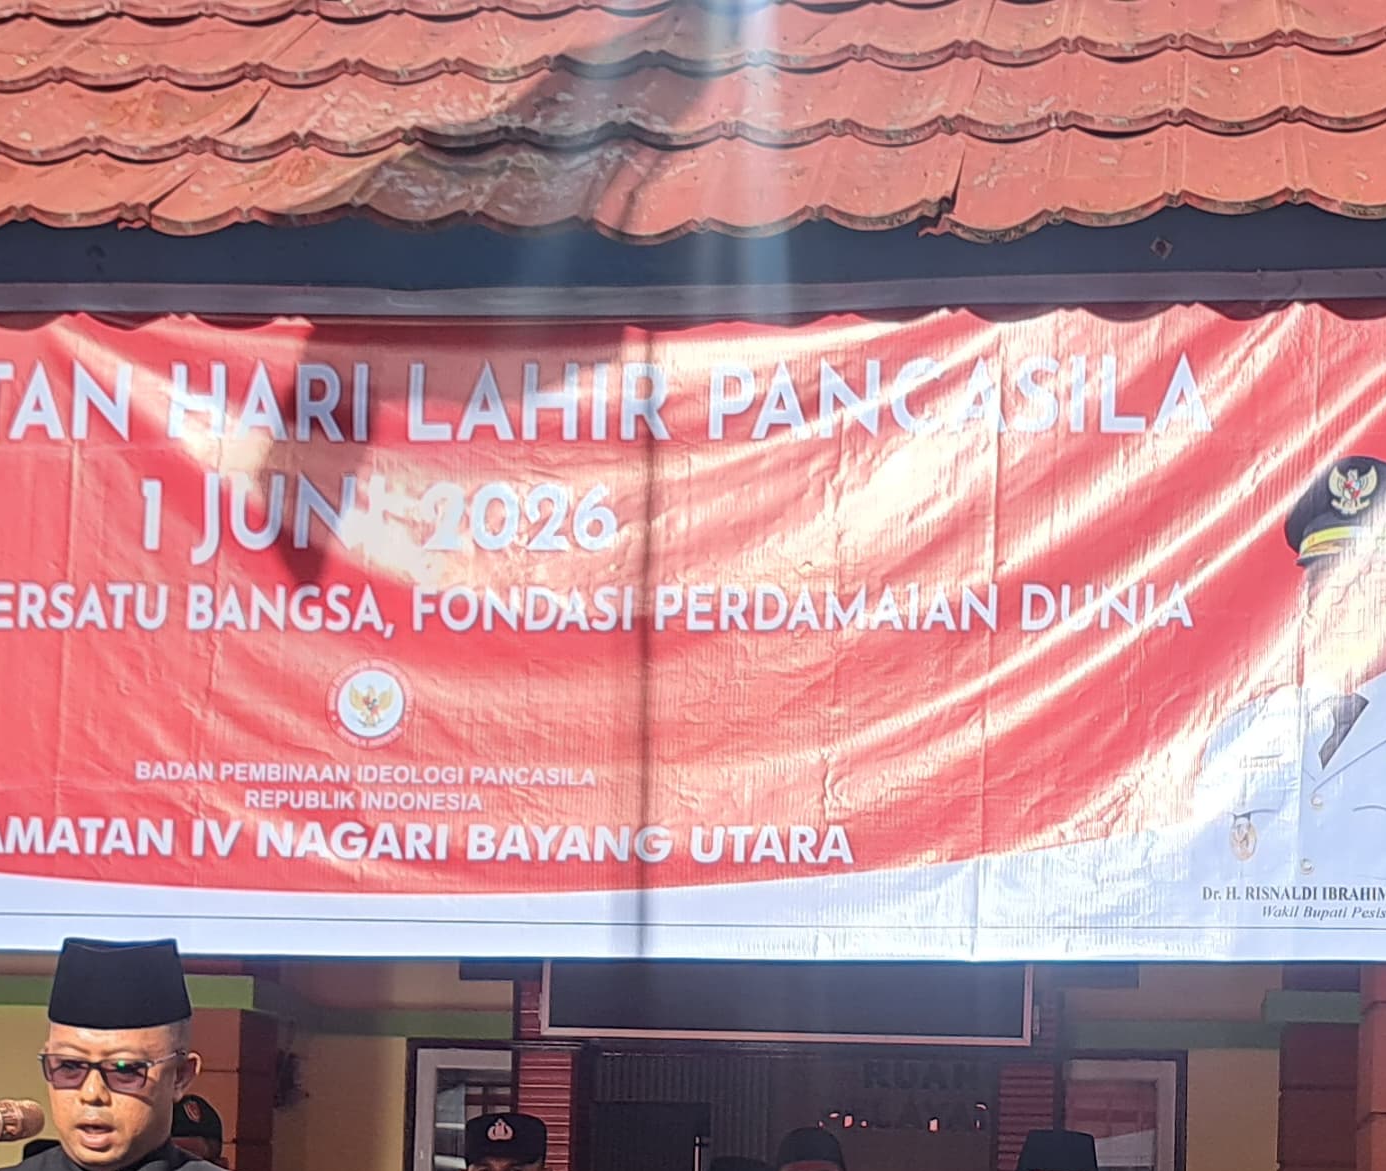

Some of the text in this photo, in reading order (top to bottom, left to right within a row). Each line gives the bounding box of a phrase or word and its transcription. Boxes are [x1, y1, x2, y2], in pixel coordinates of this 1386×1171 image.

[166, 360, 369, 443] HARI
[407, 359, 670, 443] LAHIR
[708, 352, 1212, 440] PANCASILA
[141, 478, 162, 551] 1
[419, 480, 617, 552] 2026
[186, 583, 394, 639] BANGSA,
[413, 583, 632, 632] FONDASI
[654, 582, 998, 632] PERDAMAIAN
[1020, 581, 1195, 631] DUNIA
[134, 760, 595, 787] BADAN PEMBINAAN IDEOLOGI PANCASILA
[245, 791, 482, 811] REPUBLIK INDONESIA
[192, 818, 243, 856] IV
[256, 820, 448, 861] NAGARI
[466, 824, 674, 863] BAYANG
[690, 825, 853, 863] UTARA
[1202, 886, 1222, 900] Dr.
[1226, 886, 1241, 900] H.
[1245, 886, 1318, 901] RISNALDI
[1262, 905, 1299, 918] Wakil
[1303, 905, 1348, 921] Bupati
